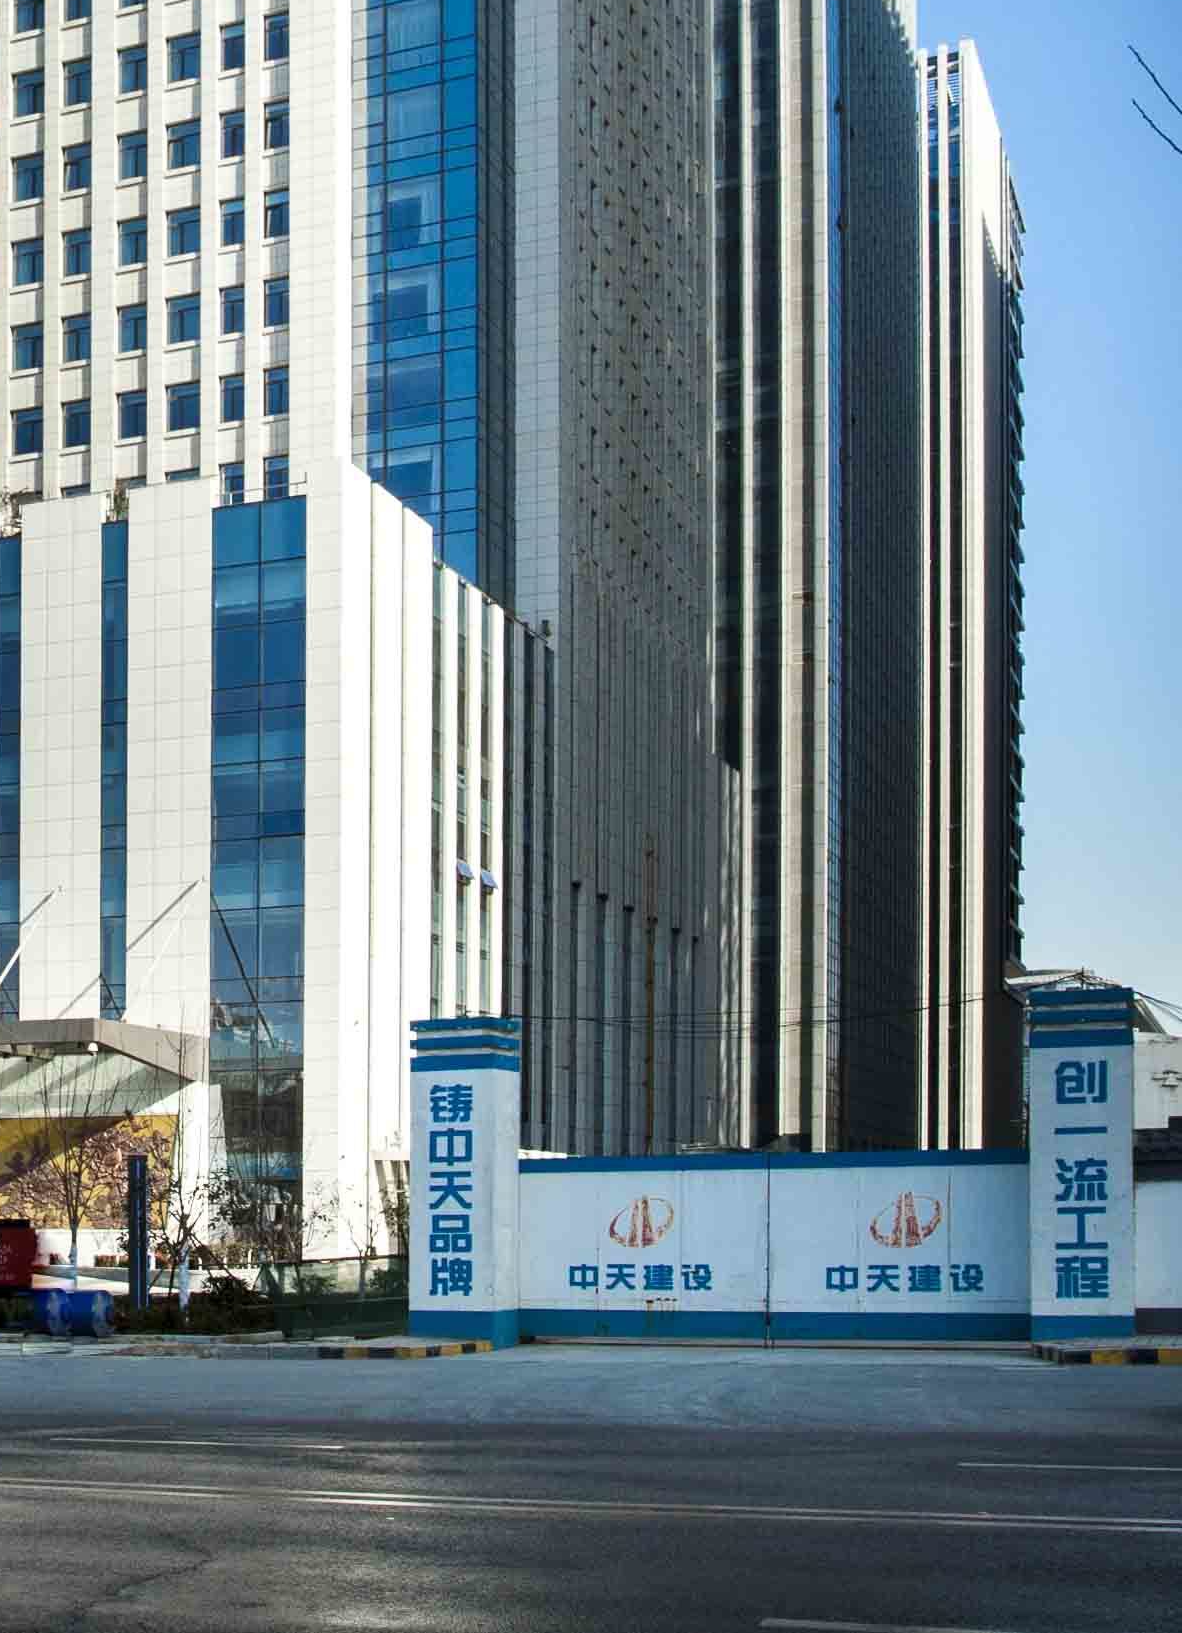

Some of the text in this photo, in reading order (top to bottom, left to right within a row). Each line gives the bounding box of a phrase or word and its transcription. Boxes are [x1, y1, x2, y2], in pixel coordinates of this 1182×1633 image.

[428, 1083, 474, 1297] 铸中天品牌
[1054, 1059, 1110, 1300] 创一流工程
[568, 1263, 713, 1291] 中天建设
[825, 1263, 985, 1293] 中天建设
